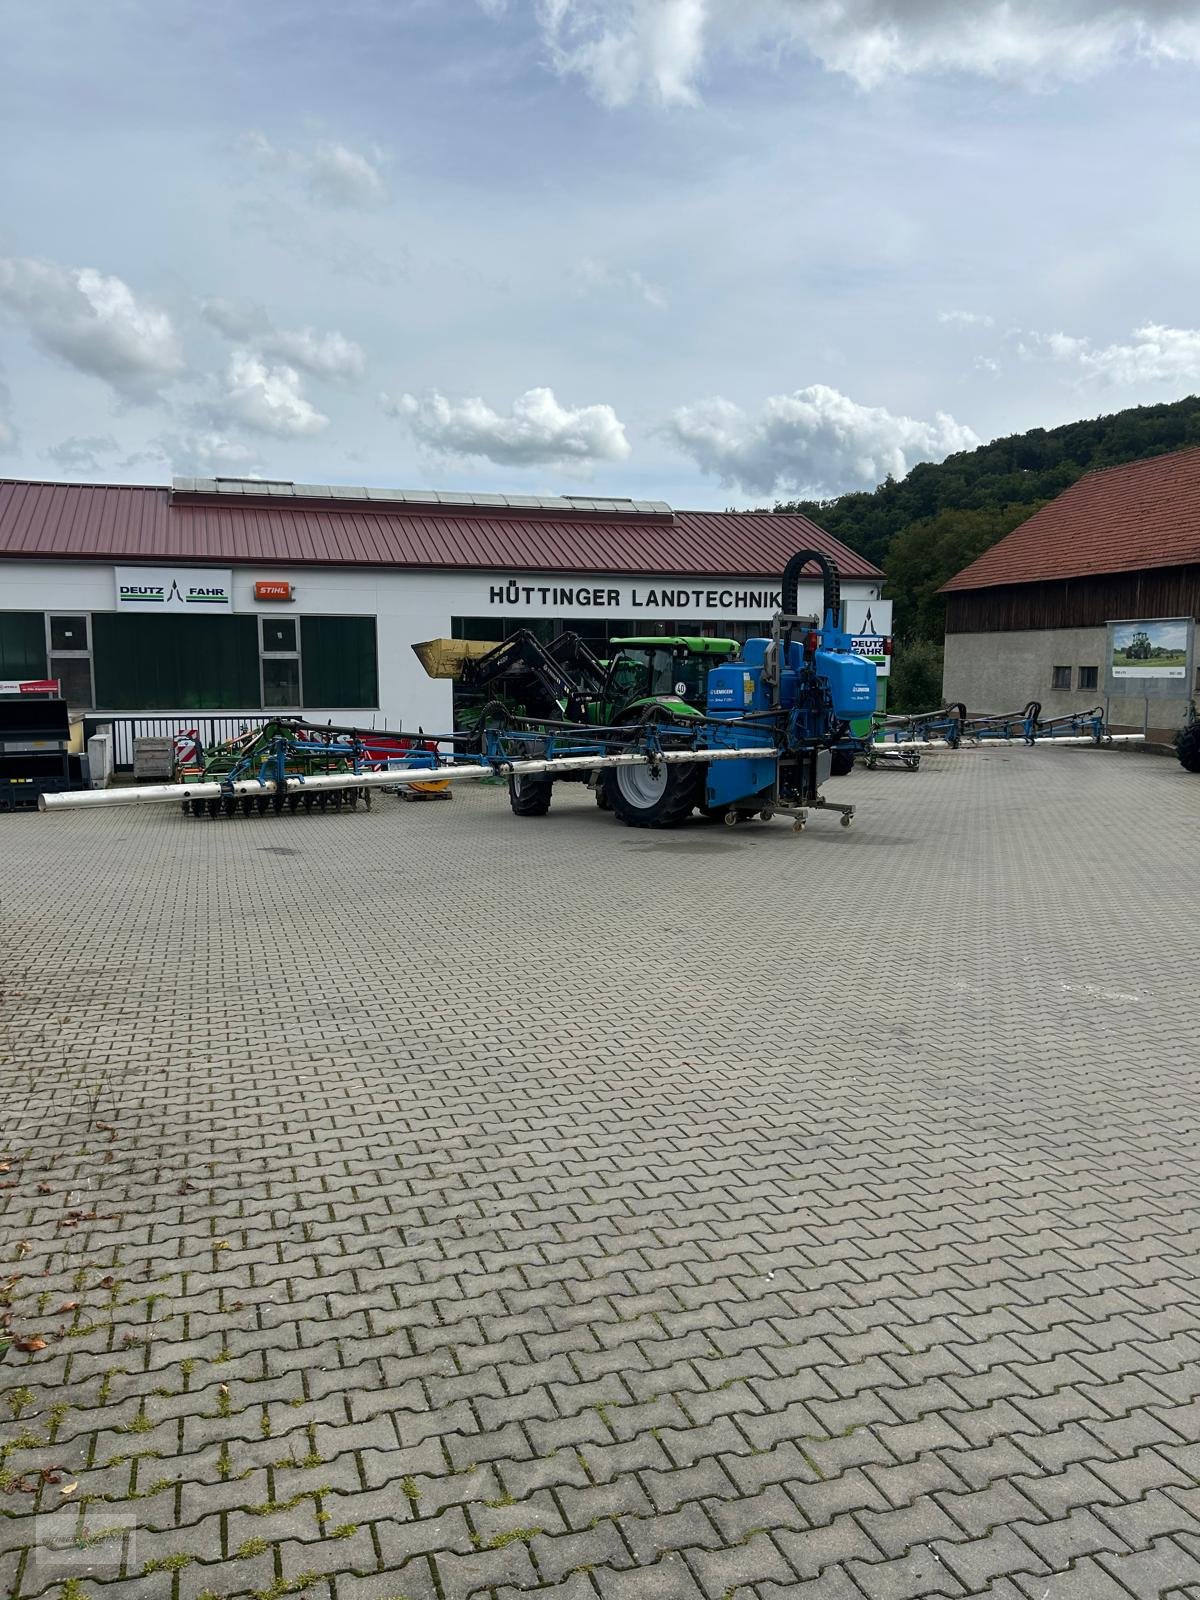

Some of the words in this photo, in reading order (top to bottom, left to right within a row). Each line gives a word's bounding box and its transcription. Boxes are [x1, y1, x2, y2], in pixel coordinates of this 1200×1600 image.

[120, 586, 164, 595] DEUTZ
[189, 588, 224, 596] FAHR
[490, 580, 620, 606] HÜTTINGER
[632, 589, 783, 608] LANDTECHNIK
[851, 640, 885, 648] DEUTZ
[676, 684, 684, 692] 40
